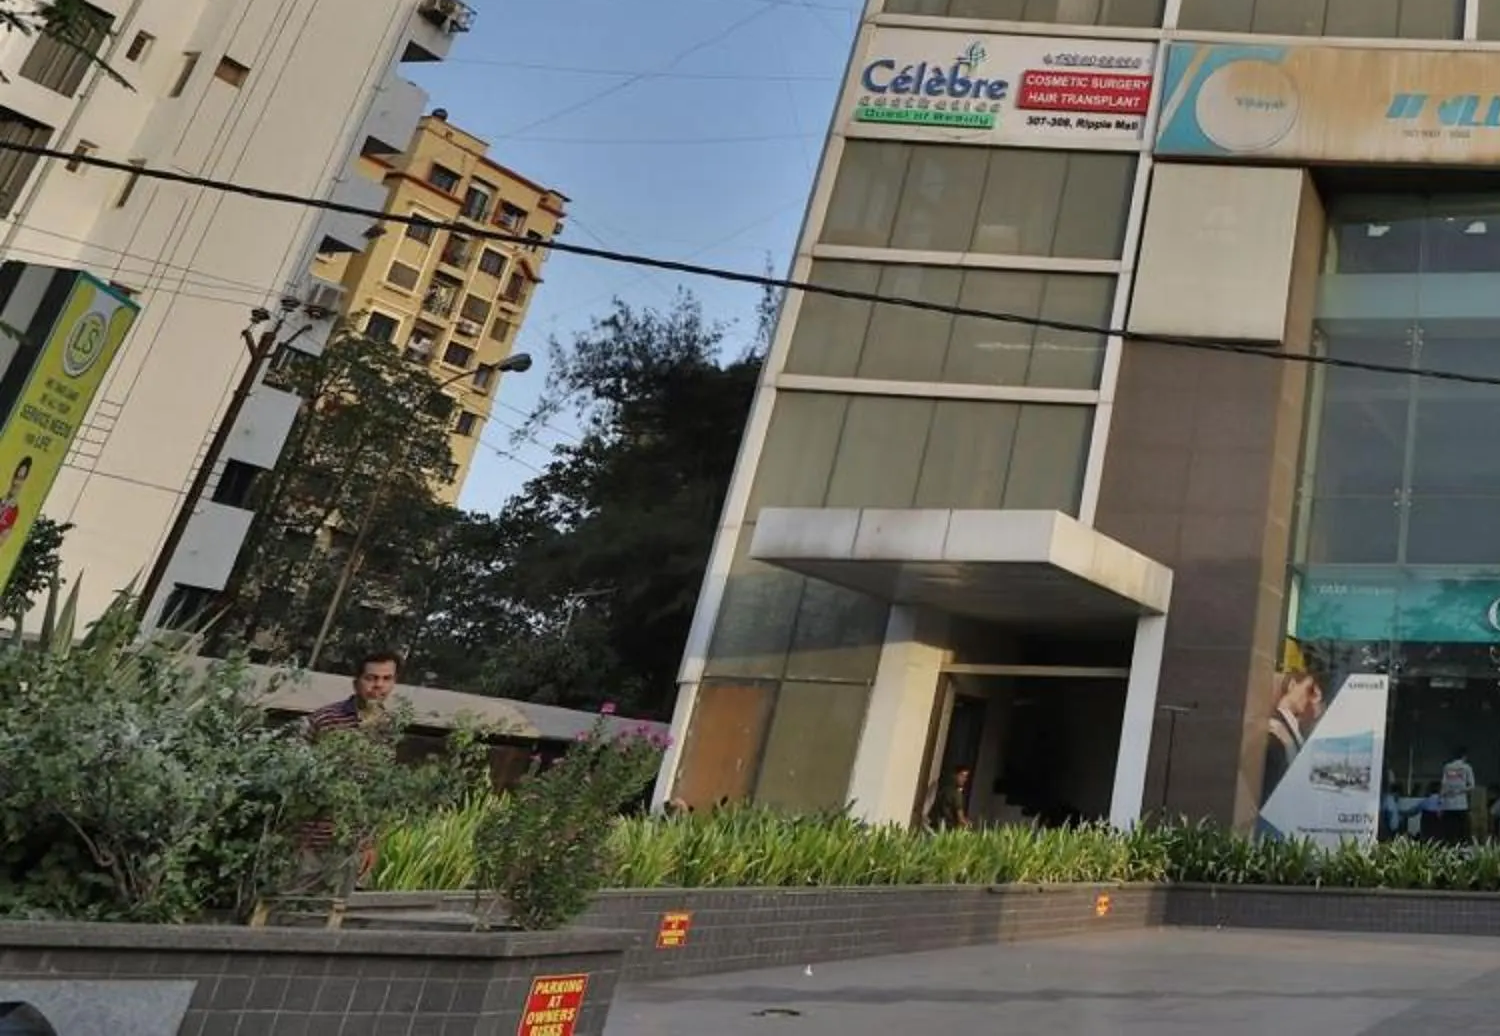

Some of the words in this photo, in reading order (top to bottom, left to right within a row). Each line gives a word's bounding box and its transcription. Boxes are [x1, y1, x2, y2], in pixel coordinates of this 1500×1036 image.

[861, 59, 1008, 100] Célèbre
[1026, 74, 1089, 88] COSMETIC
[1091, 78, 1150, 90] SURGERY
[1028, 92, 1058, 103] HAIR
[1061, 93, 1141, 107] TRANSPLANT
[534, 979, 584, 995] PARKING
[547, 995, 564, 1008] AT
[526, 1008, 576, 1025] OWNERS
